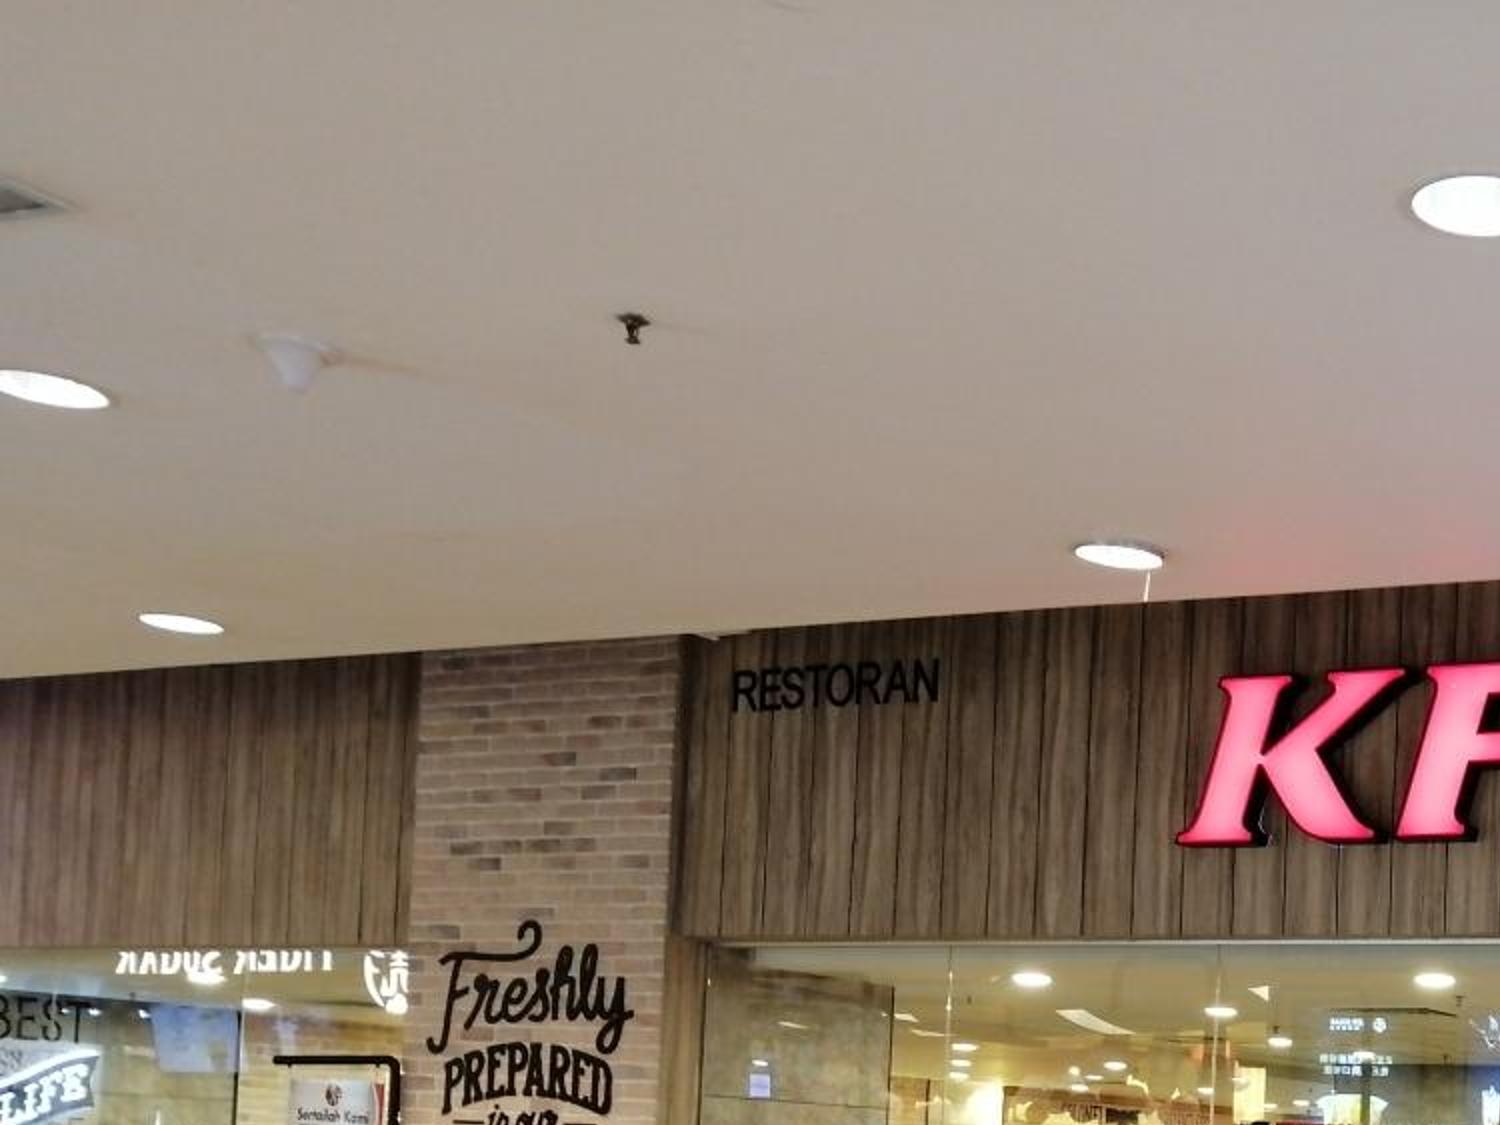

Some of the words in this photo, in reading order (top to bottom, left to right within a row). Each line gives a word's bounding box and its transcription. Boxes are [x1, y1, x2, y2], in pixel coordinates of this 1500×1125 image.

[731, 658, 940, 712] RESTORAN
[426, 919, 635, 1054] Freshly
[441, 1041, 613, 1116] PREPARED
